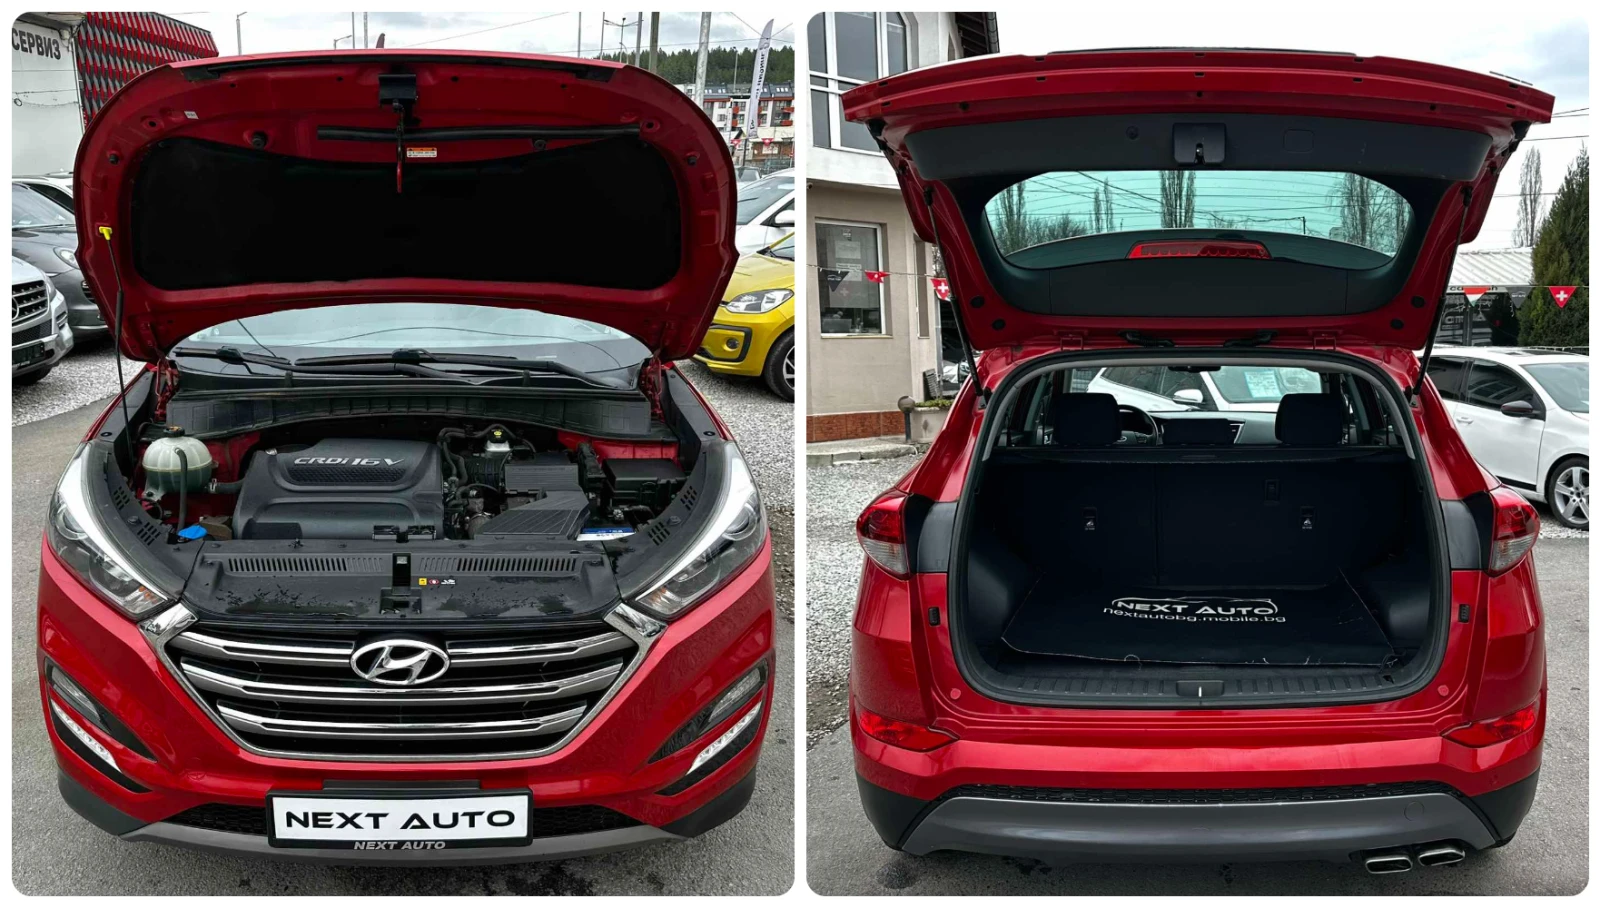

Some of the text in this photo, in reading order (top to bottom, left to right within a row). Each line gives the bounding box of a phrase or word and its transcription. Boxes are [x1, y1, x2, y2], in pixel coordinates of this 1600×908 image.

[12, 27, 61, 60] СЕРВИЗ
[1103, 606, 1286, 623] nextautobg.mobile.bg
[1116, 600, 1275, 616] NEXT AUTO
[286, 810, 515, 830] NEXT AUTO
[353, 840, 446, 851] NEXT AUTO
